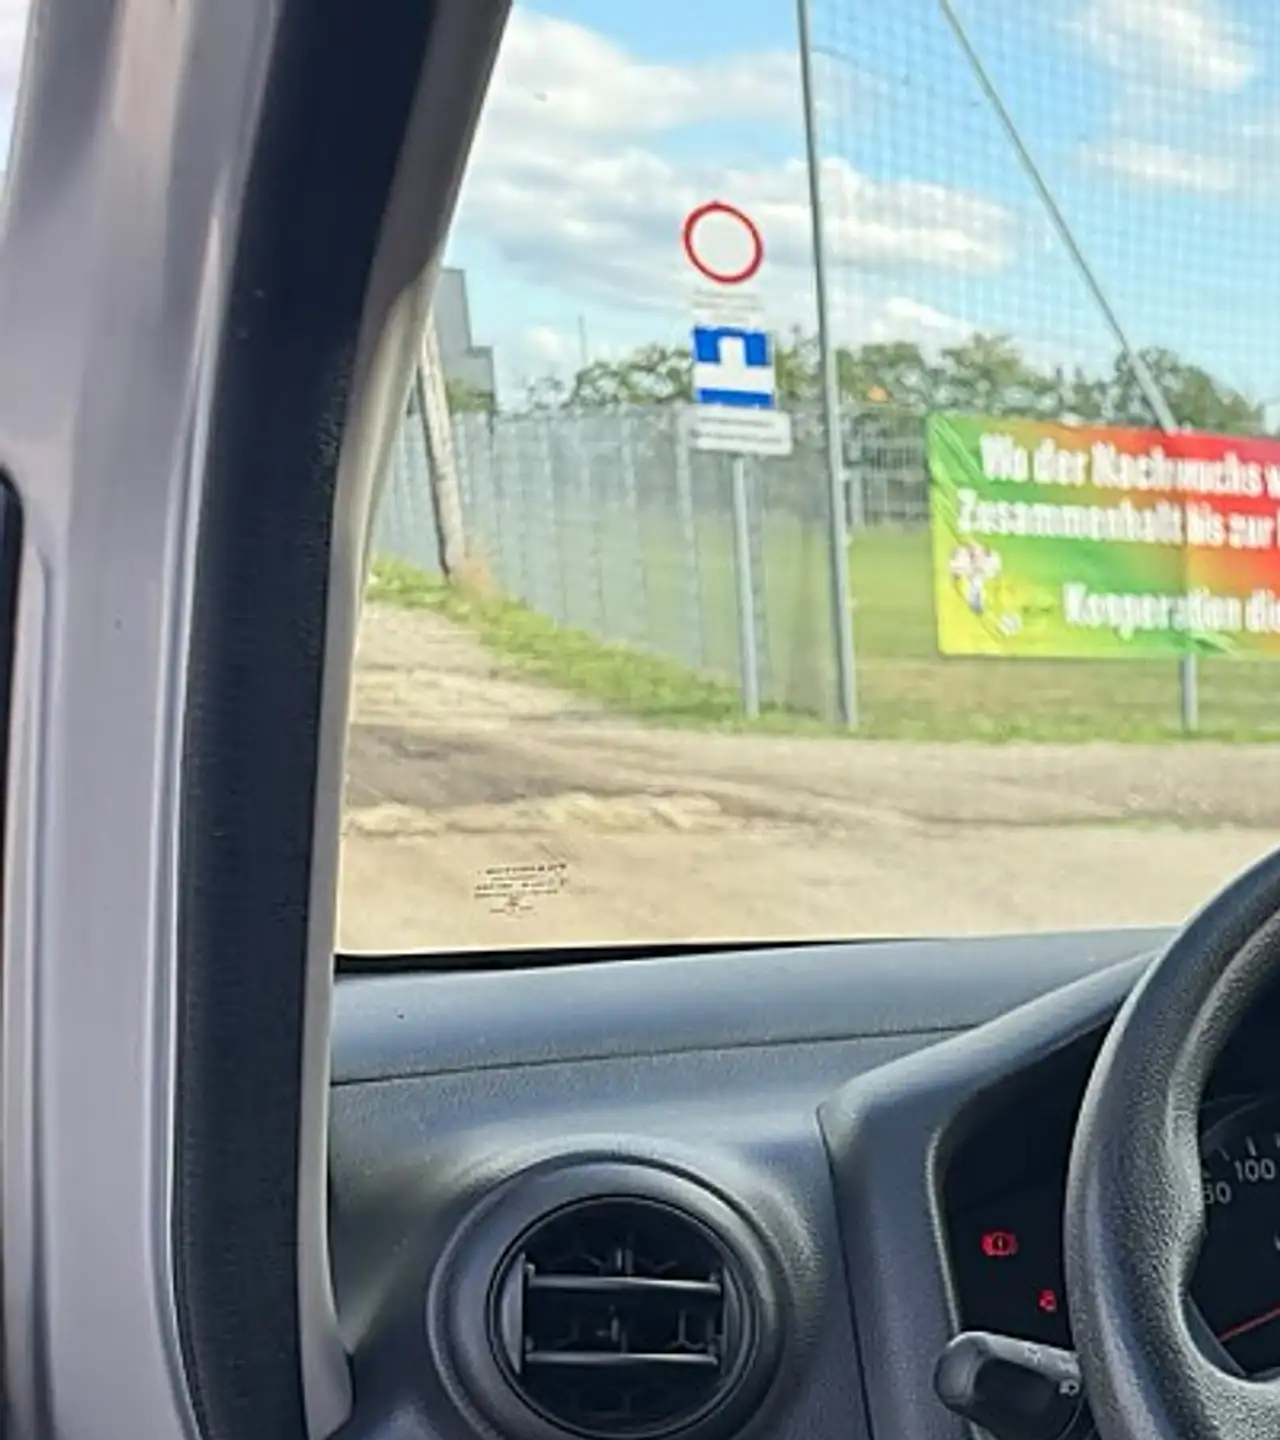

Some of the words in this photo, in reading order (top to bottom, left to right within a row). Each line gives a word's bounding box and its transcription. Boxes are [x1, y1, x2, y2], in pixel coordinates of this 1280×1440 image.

[980, 432, 1028, 482] Wo
[1033, 437, 1088, 487] der
[1234, 1158, 1276, 1182] 100
